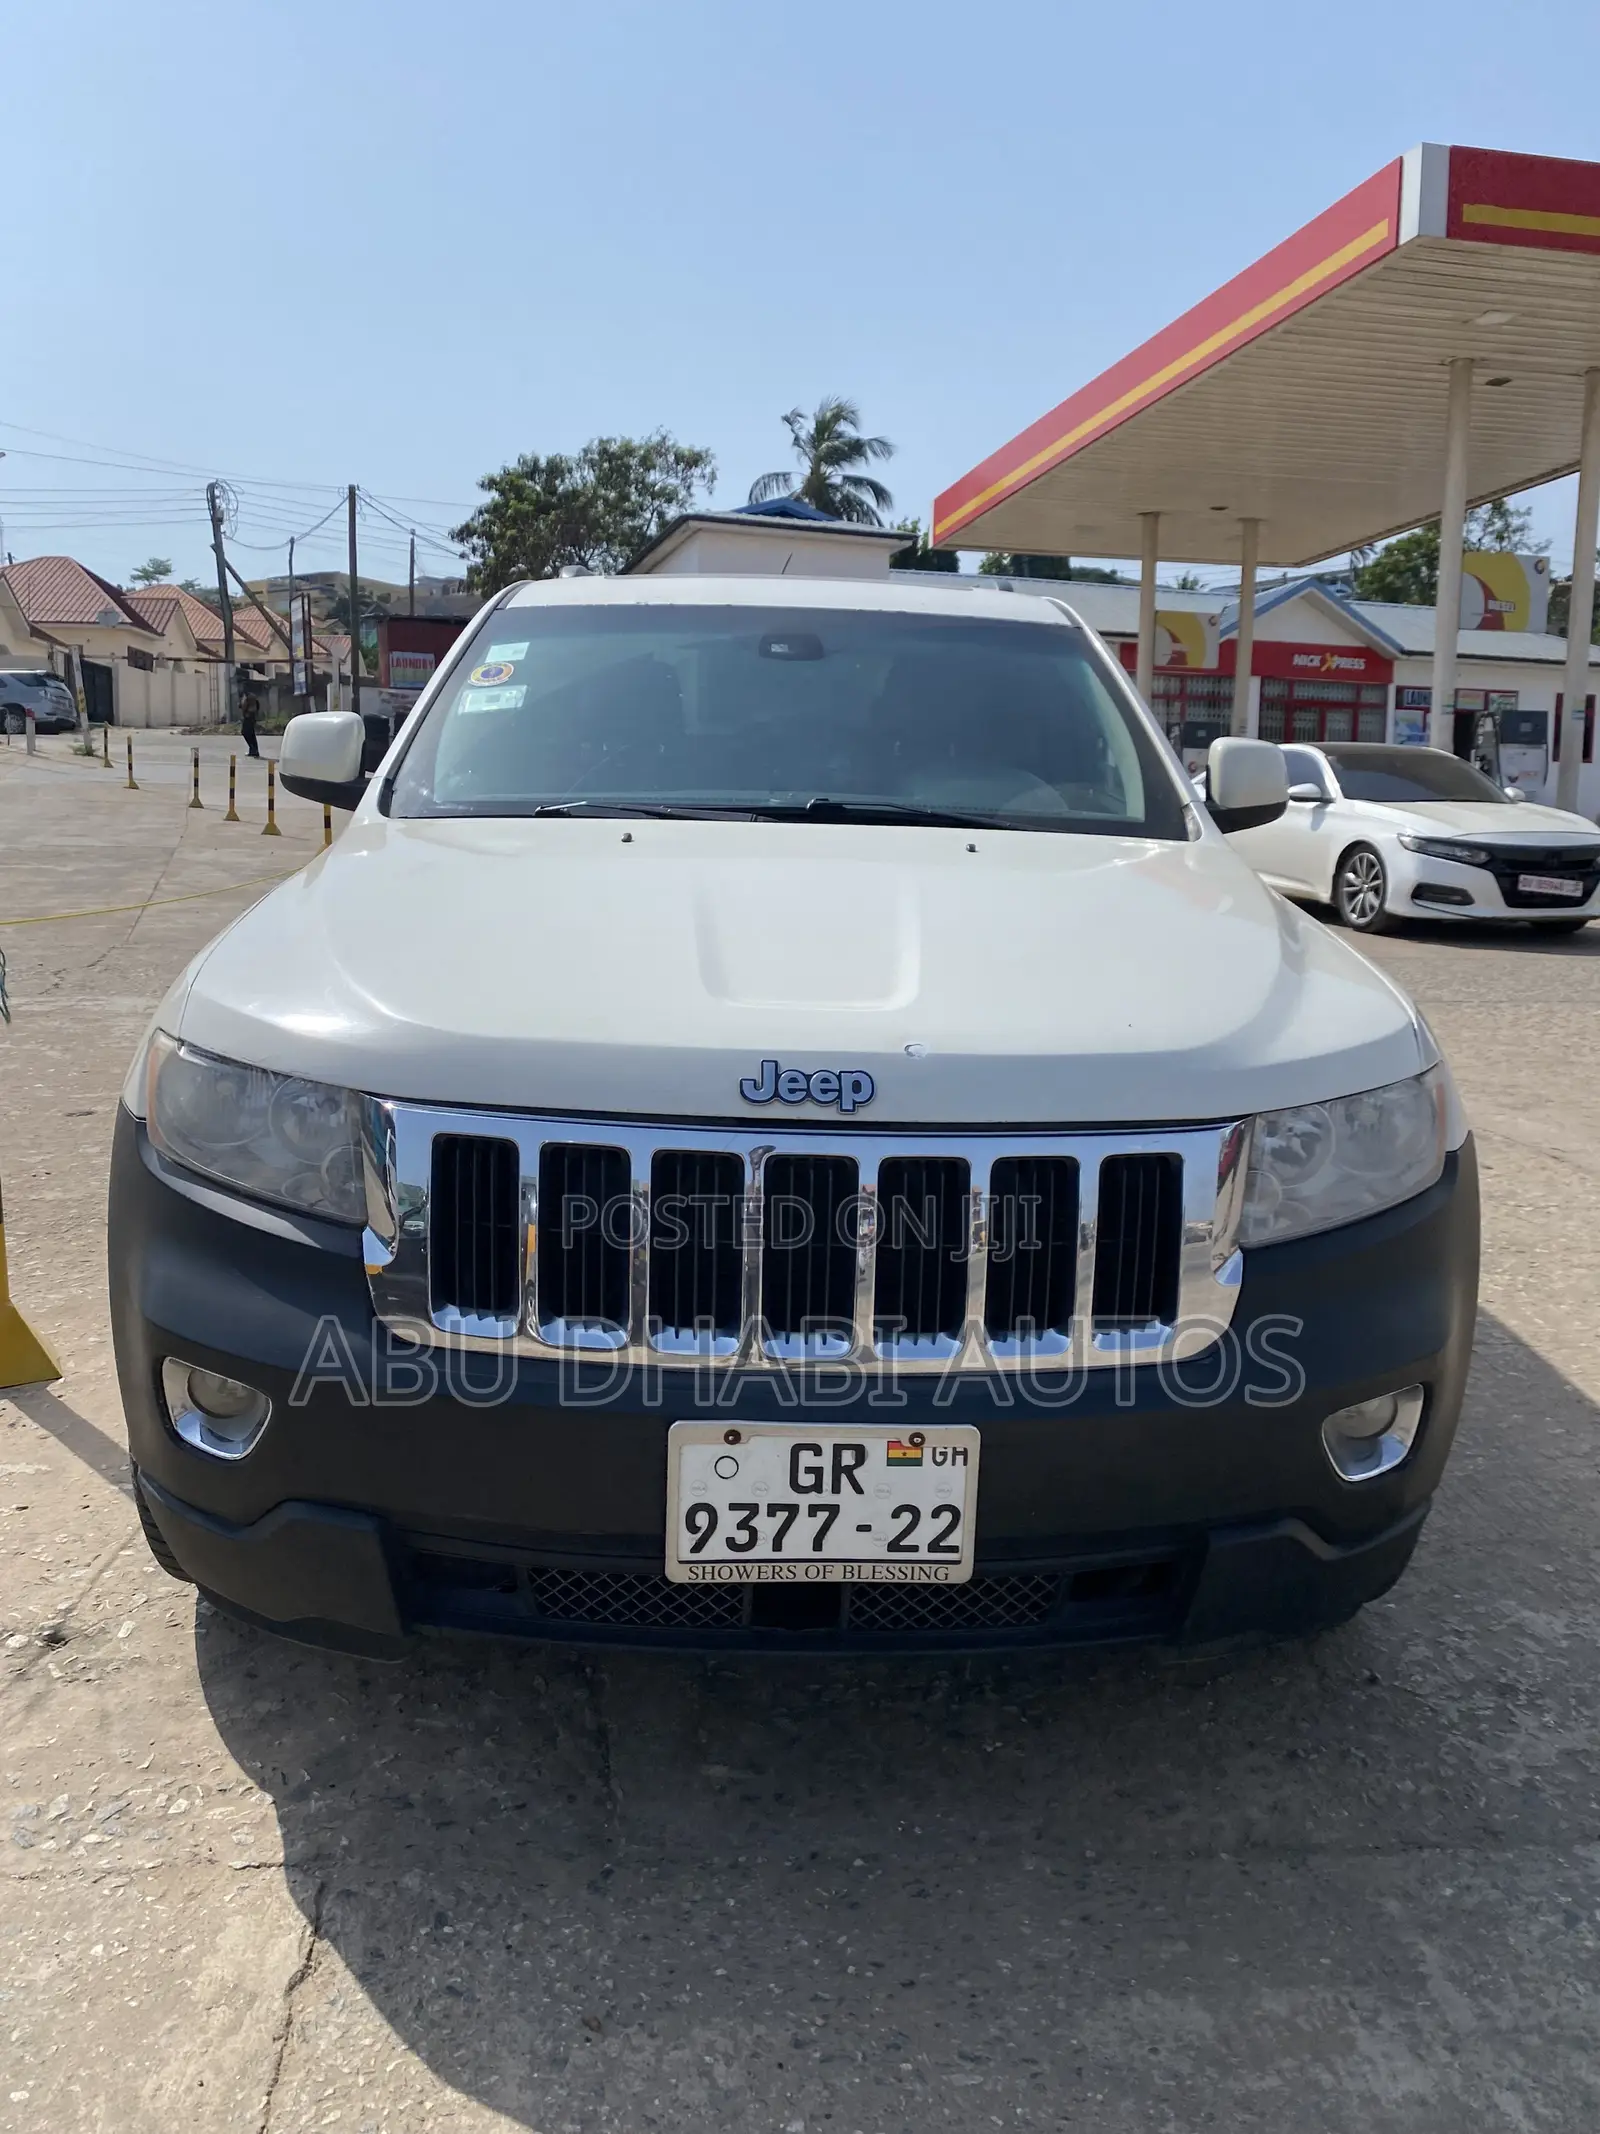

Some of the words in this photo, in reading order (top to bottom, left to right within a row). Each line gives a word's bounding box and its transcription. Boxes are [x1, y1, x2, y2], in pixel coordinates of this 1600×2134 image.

[391, 656, 434, 670] LAUNDRY
[739, 1059, 876, 1114] Jeep
[788, 1442, 868, 1495] GR
[931, 1446, 969, 1467] GH
[688, 1565, 797, 1581] SHOWERS
[804, 1565, 835, 1580] OF
[842, 1565, 950, 1582] BLESSING
